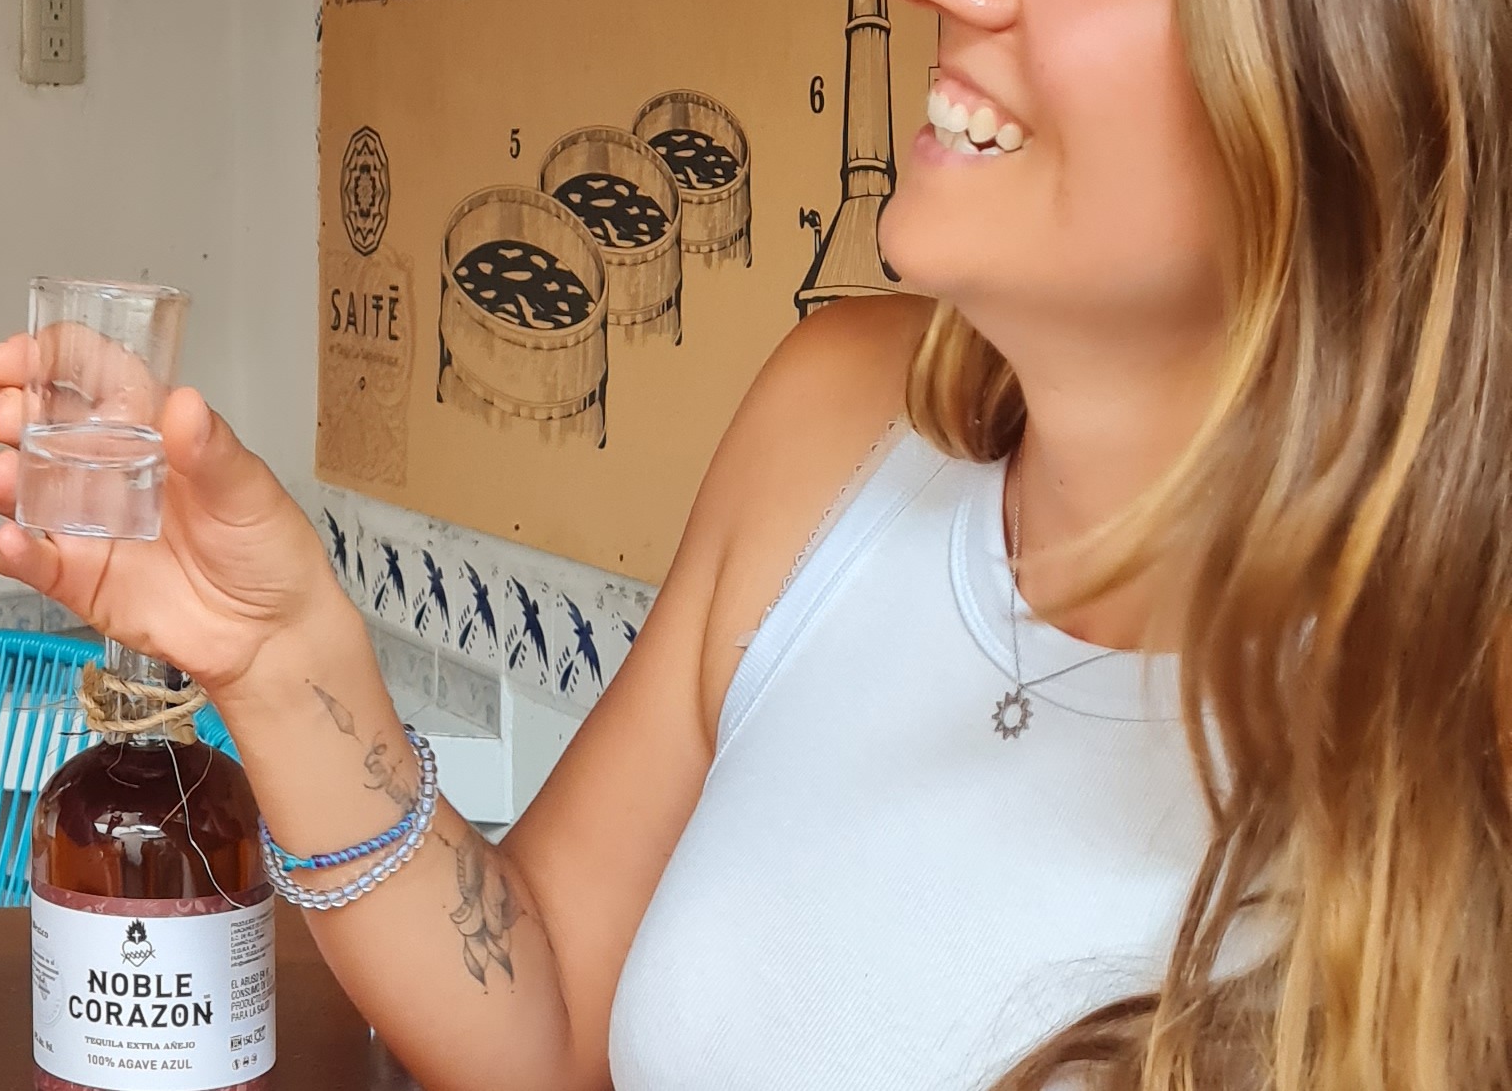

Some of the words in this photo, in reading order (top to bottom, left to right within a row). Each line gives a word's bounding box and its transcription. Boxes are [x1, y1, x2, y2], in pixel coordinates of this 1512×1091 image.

[808, 75, 825, 114] 6
[509, 128, 521, 159] 5
[87, 968, 193, 999] NOBLE
[84, 1035, 124, 1049] TEQUILA
[126, 1040, 160, 1050] EXTRA
[163, 1039, 195, 1050] AÑEJO
[87, 1053, 115, 1068] 100%
[118, 1058, 157, 1070] AGAVE
[160, 1058, 192, 1070] AZUL
